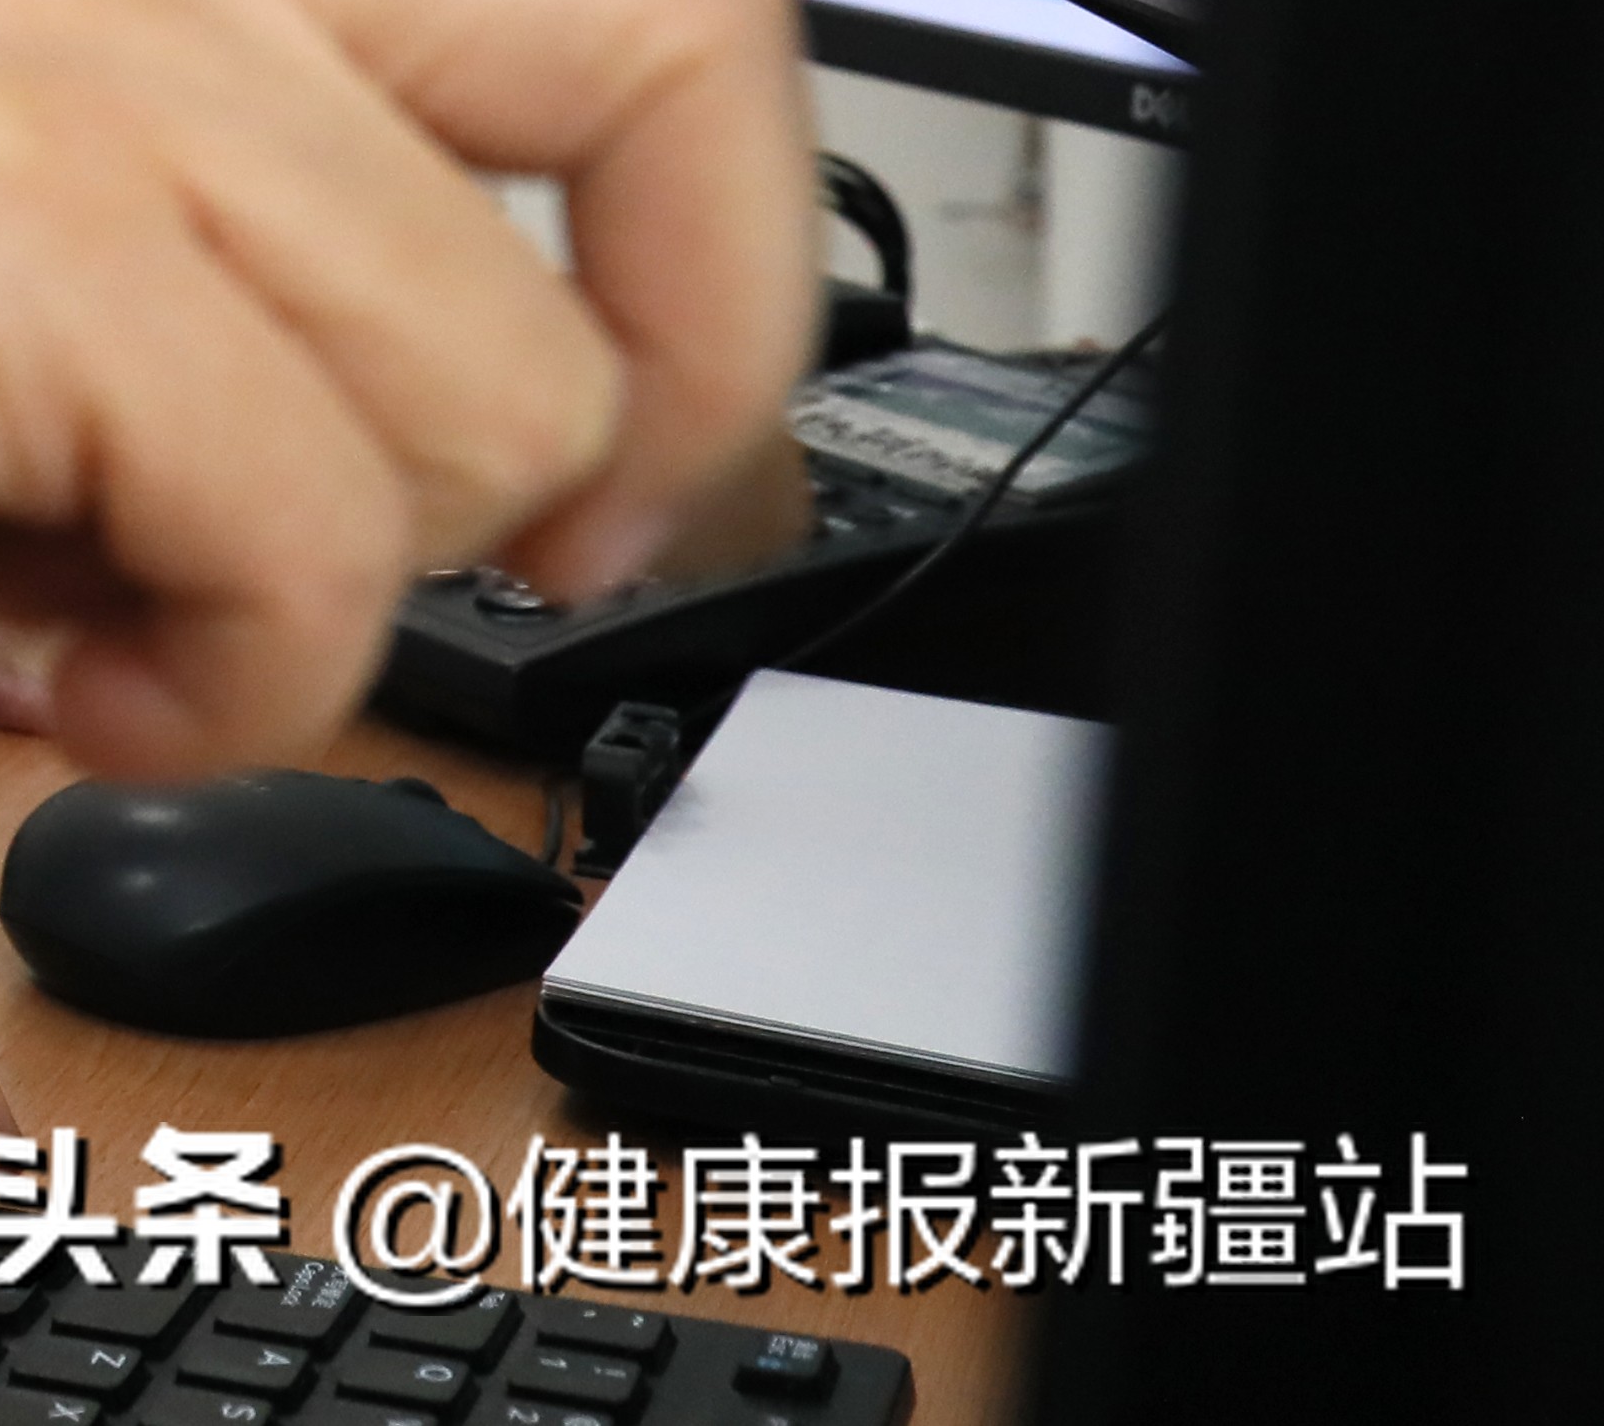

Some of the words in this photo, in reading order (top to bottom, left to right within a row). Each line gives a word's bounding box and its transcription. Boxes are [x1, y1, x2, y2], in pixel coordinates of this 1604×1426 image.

[90, 1349, 126, 1369] Z
[256, 1349, 292, 1366] A
[48, 1401, 86, 1423] X
[219, 1402, 257, 1421] S
